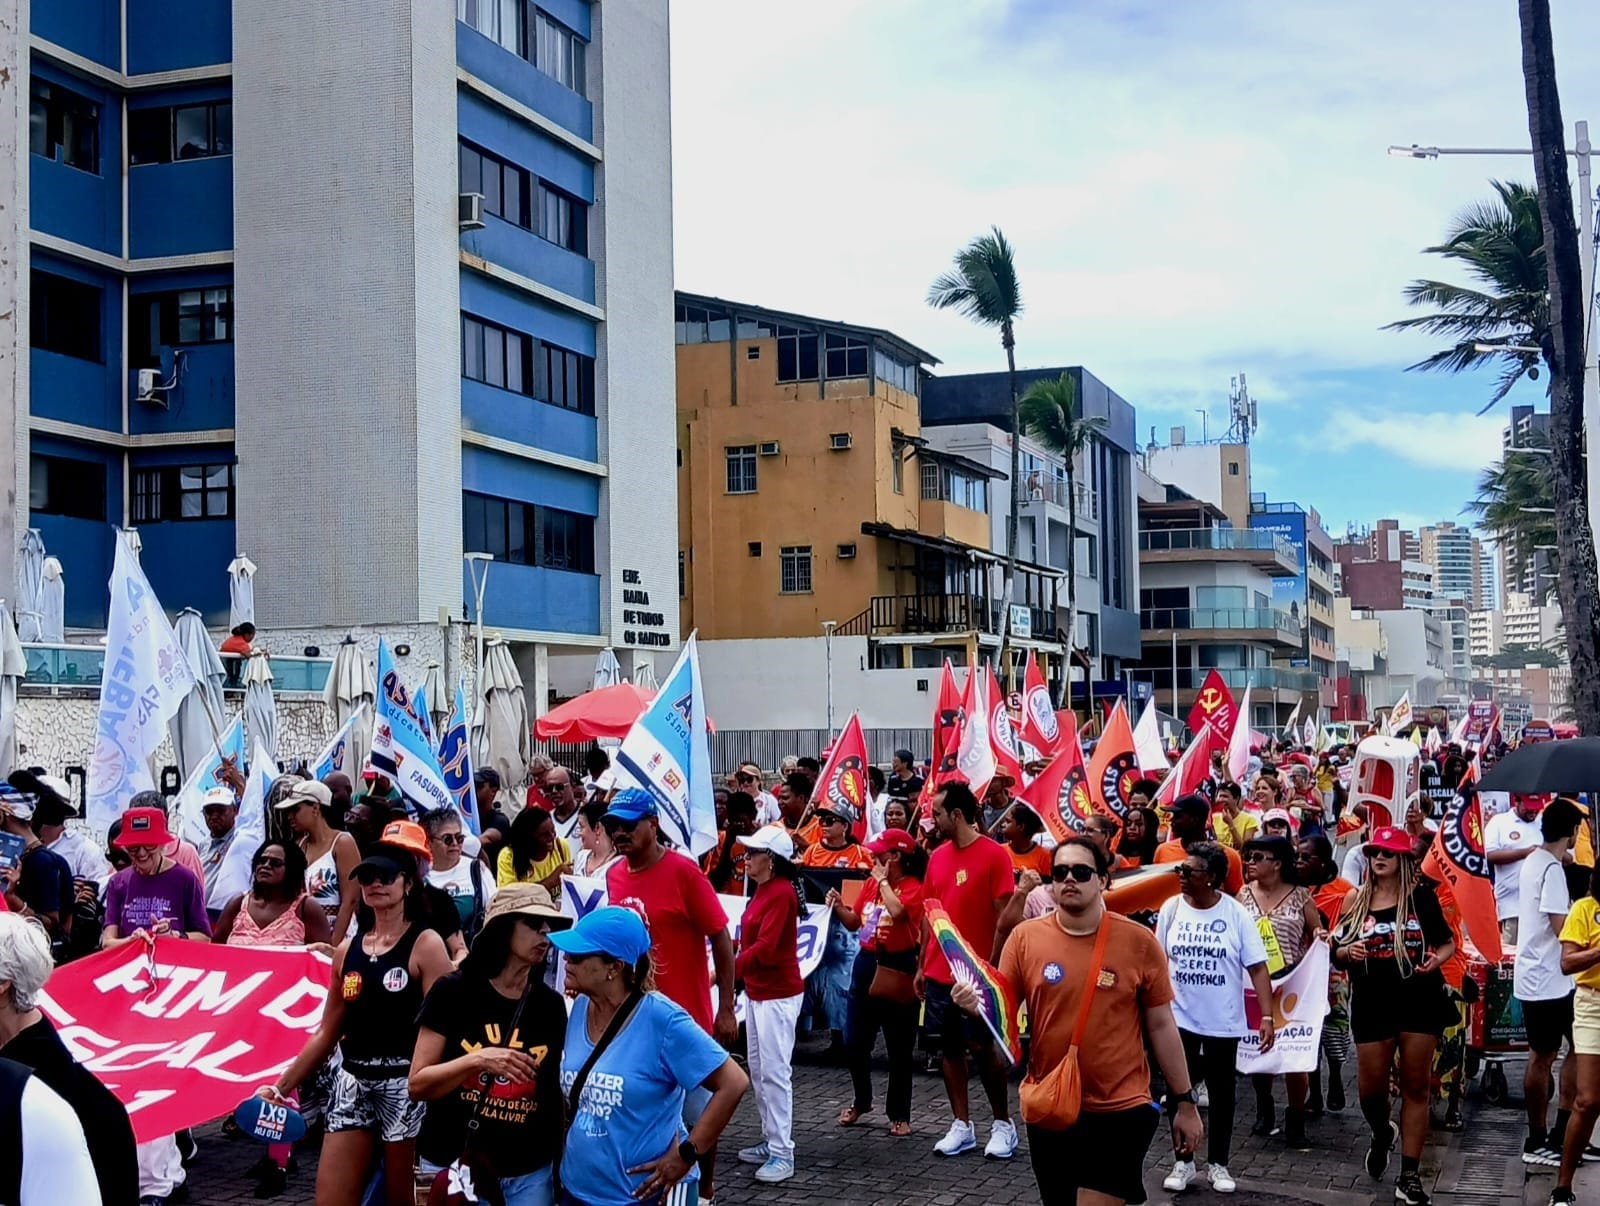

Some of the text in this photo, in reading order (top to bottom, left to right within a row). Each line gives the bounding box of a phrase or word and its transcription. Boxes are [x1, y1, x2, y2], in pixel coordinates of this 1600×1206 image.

[623, 589, 649, 605] BAHIA
[623, 609, 664, 626] DE TODOS
[624, 630, 670, 646] OS SANTOS
[1177, 932, 1221, 944] MINHA
[1179, 959, 1217, 971] SEREI
[93, 953, 273, 1019] FIM
[460, 1023, 549, 1067] LULA
[259, 1101, 287, 1125] 6X1
[498, 1110, 527, 1123] LIVRE
